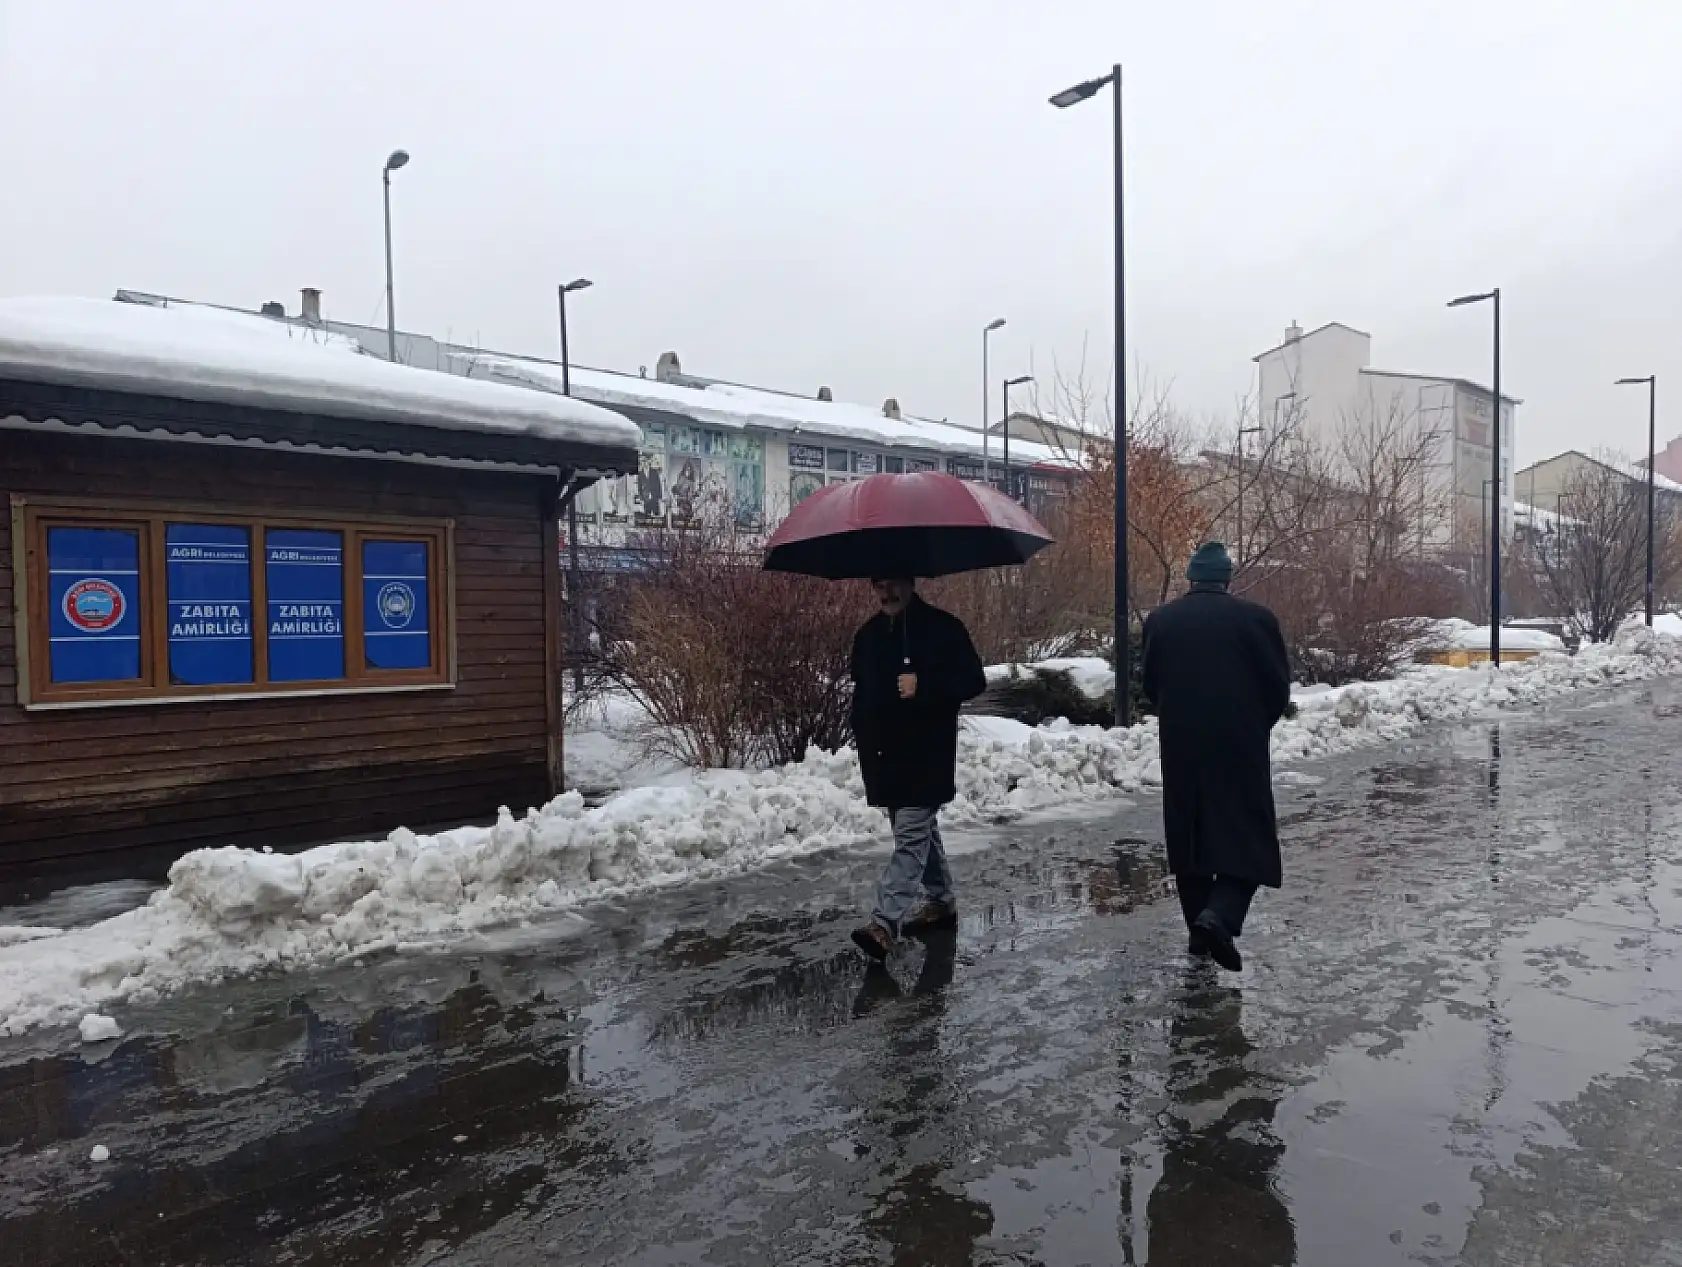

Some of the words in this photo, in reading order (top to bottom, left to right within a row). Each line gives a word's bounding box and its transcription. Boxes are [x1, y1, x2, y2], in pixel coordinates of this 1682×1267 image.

[181, 605, 240, 618] ZABITA
[279, 605, 333, 618] ZABITA
[172, 618, 248, 636] AMİRLİĞİ
[272, 618, 340, 634] AMİRLİĞİ
